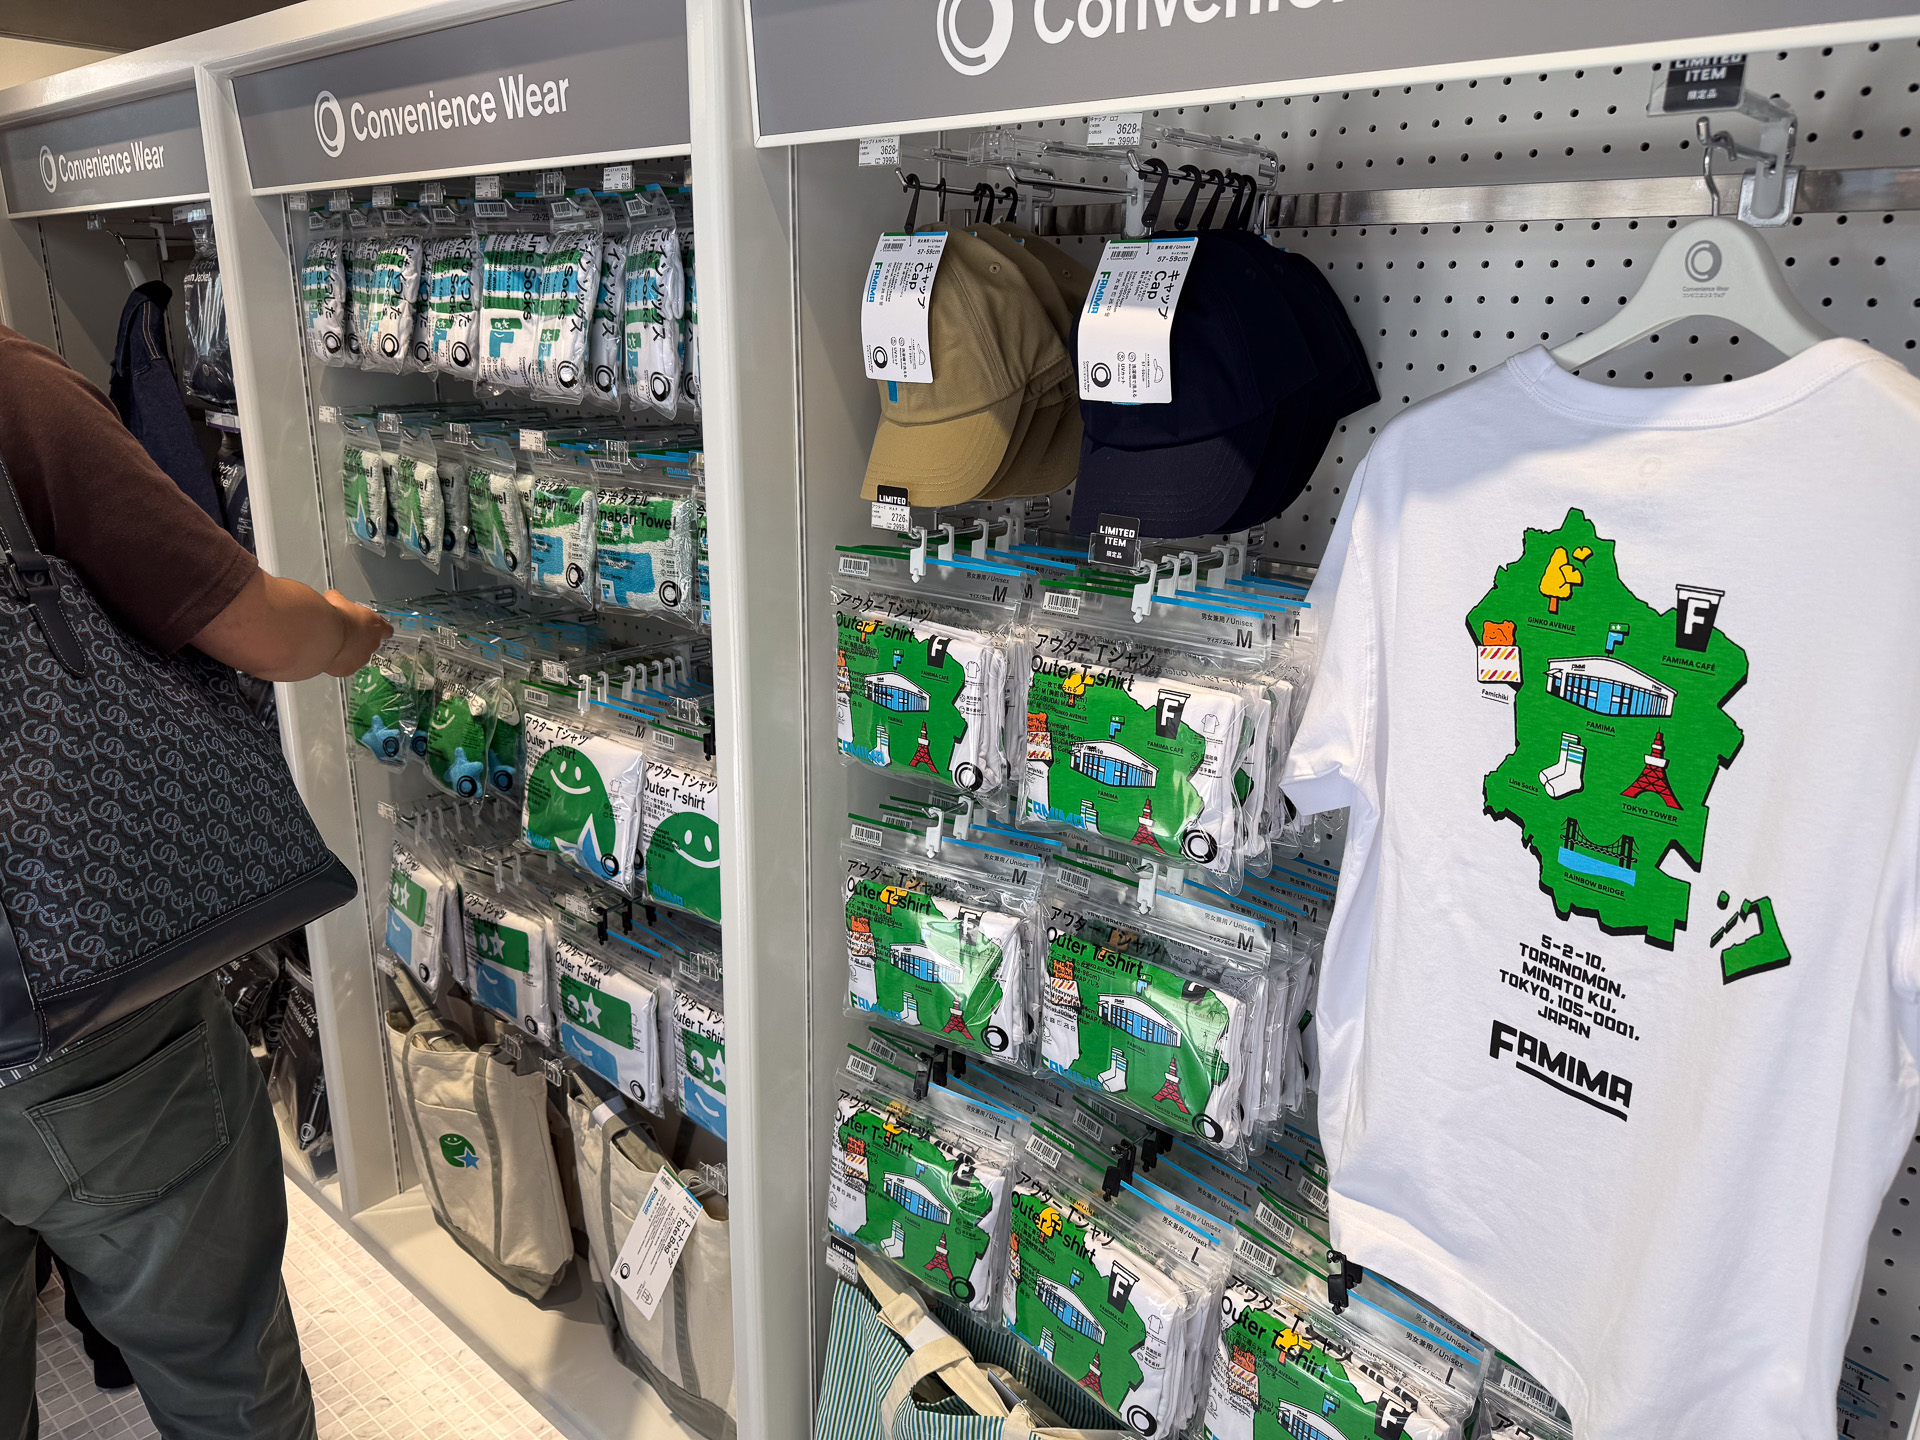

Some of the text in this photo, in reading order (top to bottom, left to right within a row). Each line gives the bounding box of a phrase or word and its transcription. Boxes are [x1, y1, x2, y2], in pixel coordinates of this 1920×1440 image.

[1685, 67, 1727, 83] ITEM
[351, 73, 569, 142] Convenience Wear
[58, 140, 165, 183] Convenience Wear
[868, 262, 884, 303] FAMIMA
[908, 262, 924, 290] Cap
[917, 262, 934, 310] キャップ
[1146, 270, 1167, 300] Cap
[522, 267, 538, 321] Socks
[557, 265, 573, 320] Socks
[641, 269, 651, 330] Socks
[1091, 271, 1112, 314] FAMIMA
[1157, 269, 1181, 320] キャップ
[558, 499, 584, 516] Towel
[597, 489, 650, 507] 今治タオル
[878, 494, 906, 505] LIMITED
[598, 509, 677, 531] mabari Towel
[1100, 525, 1136, 539] LIMITED
[1104, 537, 1127, 548] ITEM
[1106, 550, 1122, 559] 限定品
[992, 585, 1008, 602] M
[837, 593, 932, 623] アウター Tシャツ
[1201, 612, 1253, 628] 男女兼用 Unisex
[1684, 597, 1710, 635] F
[836, 610, 915, 643] Outer T-shirt
[1527, 616, 1577, 632] GINKO AVENUE
[1035, 633, 1156, 668] アウター Tシャツ
[1235, 628, 1253, 649] M
[1031, 655, 1076, 679] Outer
[1080, 664, 1135, 692] T-shirt
[1662, 655, 1716, 671] FAMIMA CAFÉ
[1481, 688, 1510, 702] Famichiki
[1161, 698, 1179, 726] F
[525, 714, 591, 747] アウター Tシャツ
[634, 725, 646, 739] M
[1586, 721, 1616, 734] FAMIMA
[525, 730, 546, 749] Outer
[547, 740, 577, 761] T-shirt
[1147, 740, 1169, 751] FAMIMA
[646, 761, 718, 794] アウター Tシャツ
[1509, 777, 1539, 793] Line Socks
[672, 786, 706, 811] T-shirt
[1098, 790, 1119, 800] FAMIMA
[1026, 797, 1086, 830] FAMIMA
[1622, 802, 1678, 822] TOKYO TOWER
[848, 859, 894, 880] アウター
[898, 872, 948, 897] Tシャツ
[1011, 868, 1028, 886] M
[1564, 871, 1625, 897] RAINBOW BRIDGE
[847, 874, 880, 900] Outer
[885, 888, 932, 915] T-shirt
[1050, 905, 1101, 932] アウター
[1106, 925, 1166, 957] Tシャツ
[1204, 912, 1256, 933] 男女兼用 Unisex
[557, 937, 584, 960] アウター
[1046, 926, 1087, 955] Outer
[1092, 943, 1144, 978] T-shirt
[1237, 932, 1255, 952] M
[556, 951, 601, 990] Outer T-shirt
[1522, 961, 1584, 1000] MINATO
[674, 989, 705, 1014] アウター
[673, 1006, 696, 1029] Outer
[1538, 1006, 1591, 1039] JAPAN
[1489, 1020, 1633, 1109] FAMIMA
[837, 1088, 881, 1117] アウター
[835, 1109, 868, 1137] Outer
[870, 1124, 914, 1158] T-shirt
[994, 1125, 1001, 1141] L
[1284, 1164, 1293, 1181] L
[1015, 1171, 1063, 1210] アウター
[1065, 1203, 1116, 1247] Tシャツ
[1243, 1190, 1252, 1207] L
[663, 1216, 685, 1255] Tote Bag
[1011, 1190, 1047, 1229] Outer
[1046, 1219, 1096, 1266] T-shirt
[1161, 1215, 1209, 1248] 男女兼用 Unisex
[668, 1223, 691, 1268] トートバッグ
[831, 1242, 856, 1262] LIMITED
[1190, 1246, 1201, 1267] L
[1112, 1272, 1130, 1298] F
[1225, 1275, 1287, 1320] アウター
[1290, 1314, 1354, 1362] Tシャツ
[1221, 1295, 1267, 1340] Outer
[1271, 1328, 1328, 1383] T-shirt
[1405, 1331, 1464, 1369] 男女兼用 Unisex
[1445, 1333, 1470, 1353] Unisex
[1445, 1366, 1456, 1389] L
[1845, 1363, 1874, 1382] Unisex
[1858, 1377, 1871, 1396] L
[1380, 1399, 1406, 1429] F
[1842, 1418, 1856, 1440] L
